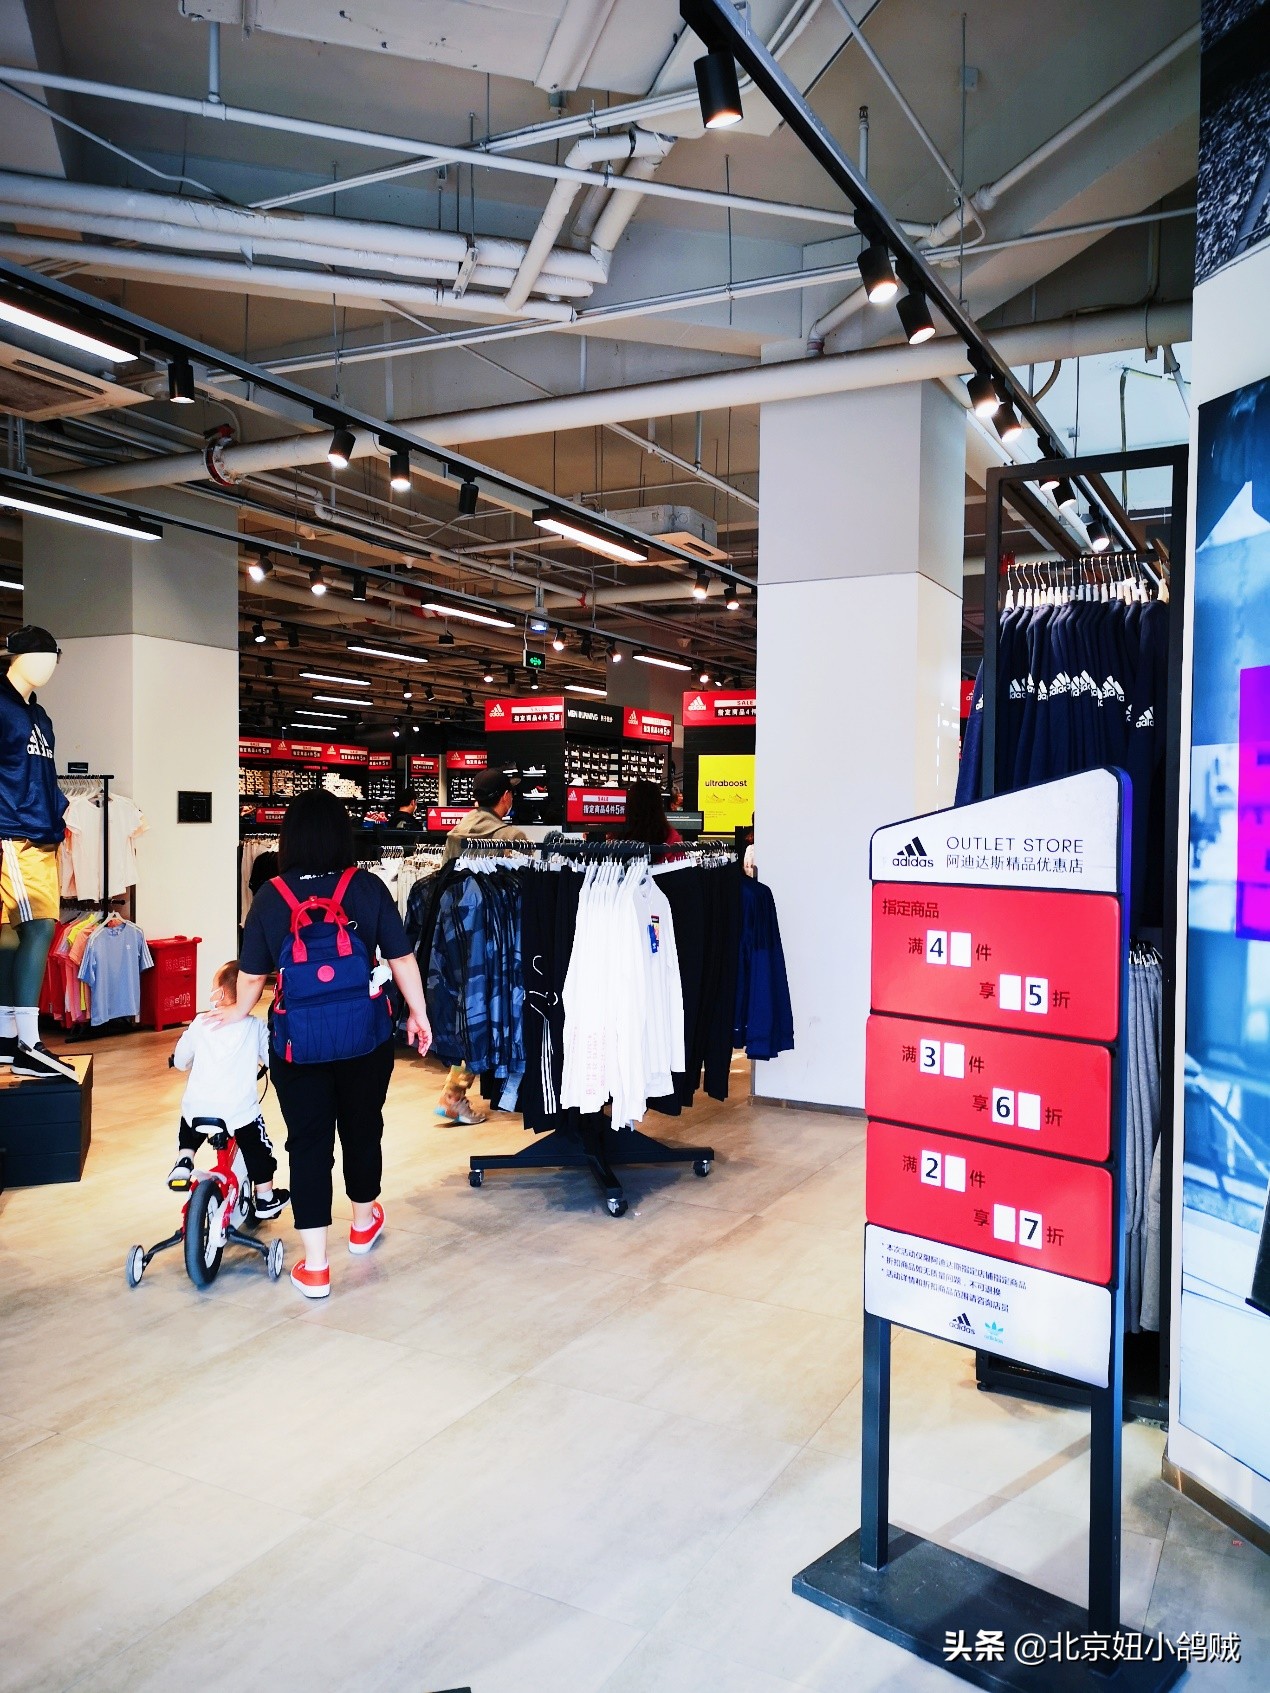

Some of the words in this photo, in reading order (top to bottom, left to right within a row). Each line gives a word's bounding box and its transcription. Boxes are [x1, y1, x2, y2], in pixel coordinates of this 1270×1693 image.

[704, 779, 748, 787] ultraboost
[583, 804, 625, 815] 指定商品4件5折
[946, 836, 1015, 851] OUTLET
[1023, 838, 1084, 854] STORE
[892, 856, 934, 868] adidas
[946, 853, 1083, 874] 阿迪达斯精品优惠店
[882, 899, 940, 919] 指定商品
[929, 937, 944, 958] 4
[975, 943, 992, 962] 件
[1029, 984, 1042, 1007] 5
[1052, 990, 1070, 1009] 折
[923, 1046, 936, 1068] 3
[968, 1055, 985, 1074] 件
[996, 1096, 1011, 1119] 6
[1045, 1106, 1063, 1127] 折
[925, 1157, 939, 1179] 2
[969, 1169, 986, 1189] 件
[1024, 1217, 1039, 1240] 7
[1046, 1225, 1065, 1247] 折
[949, 1321, 976, 1335] adidas
